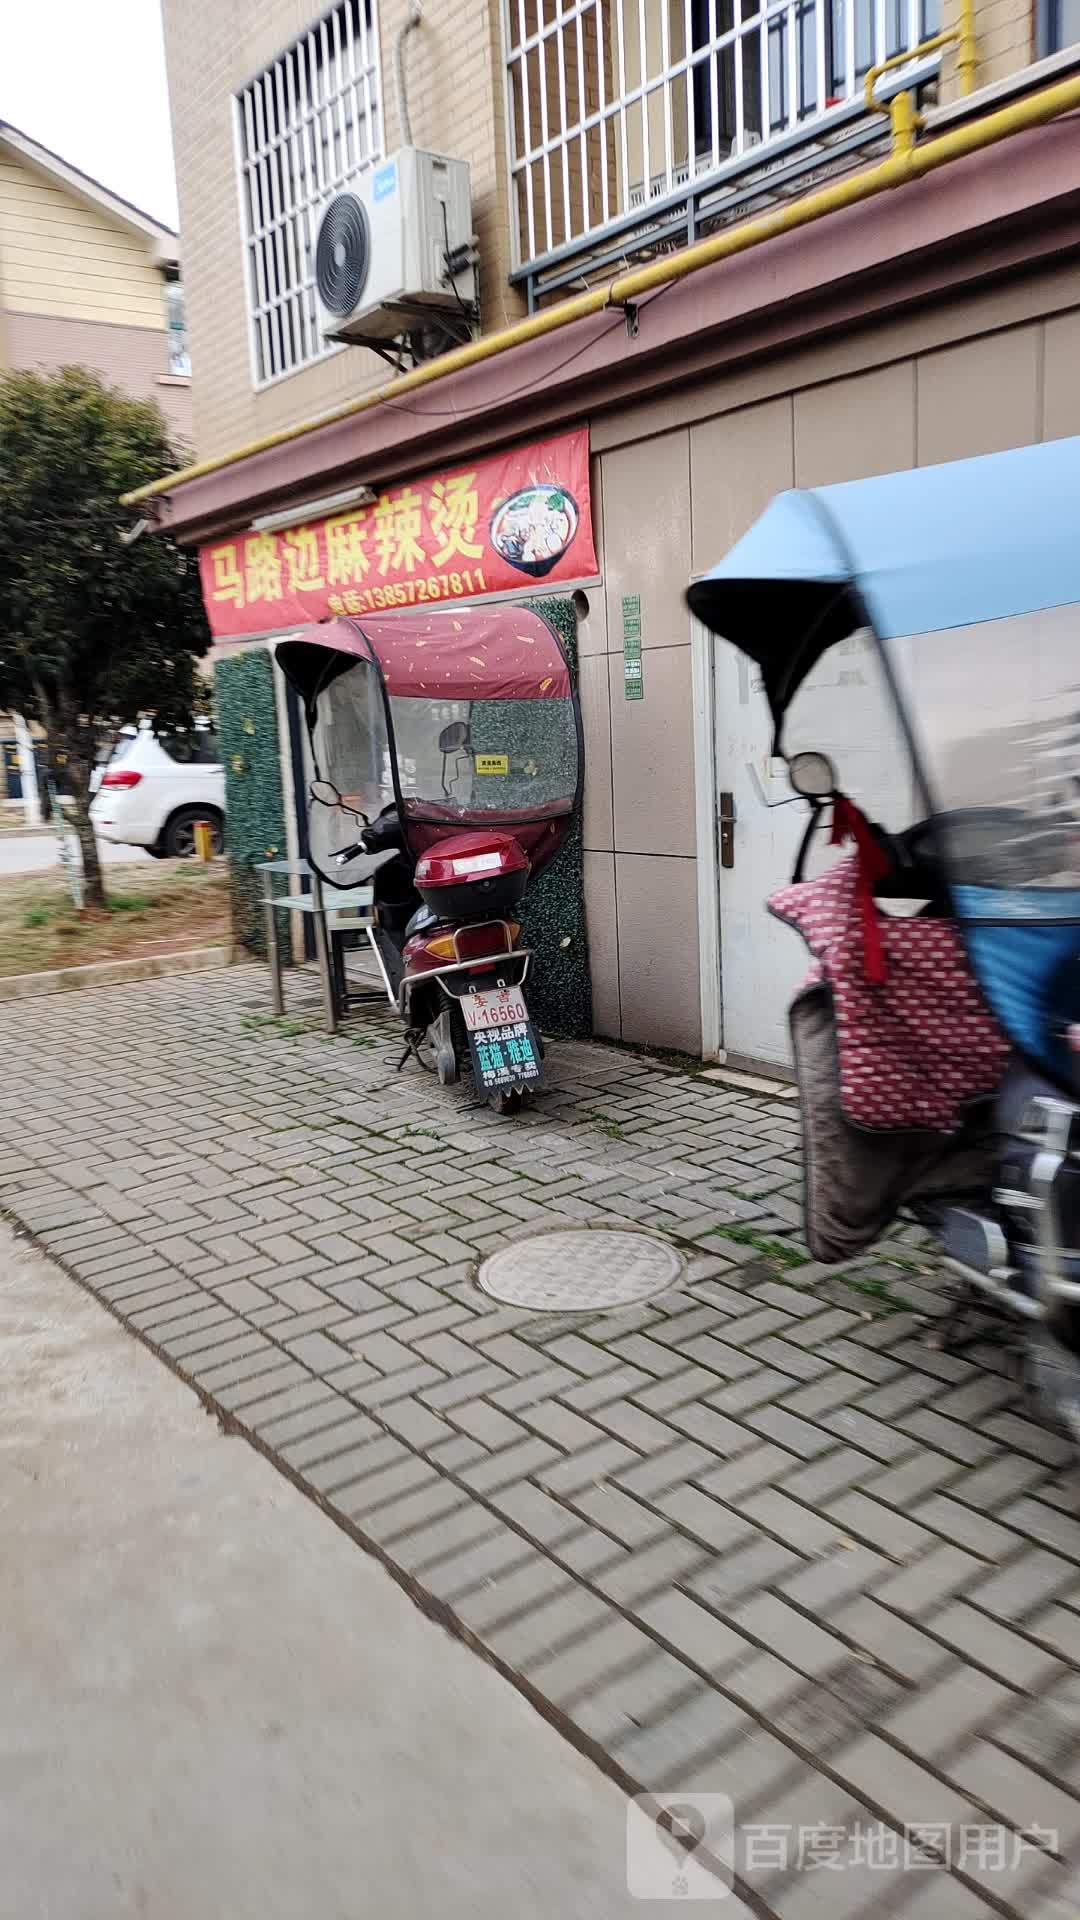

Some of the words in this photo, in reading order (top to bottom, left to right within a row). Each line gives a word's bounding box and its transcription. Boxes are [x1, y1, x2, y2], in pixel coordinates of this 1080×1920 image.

[212, 472, 484, 609] 马路边麻辣烫
[474, 1022, 528, 1046] 央视品牌
